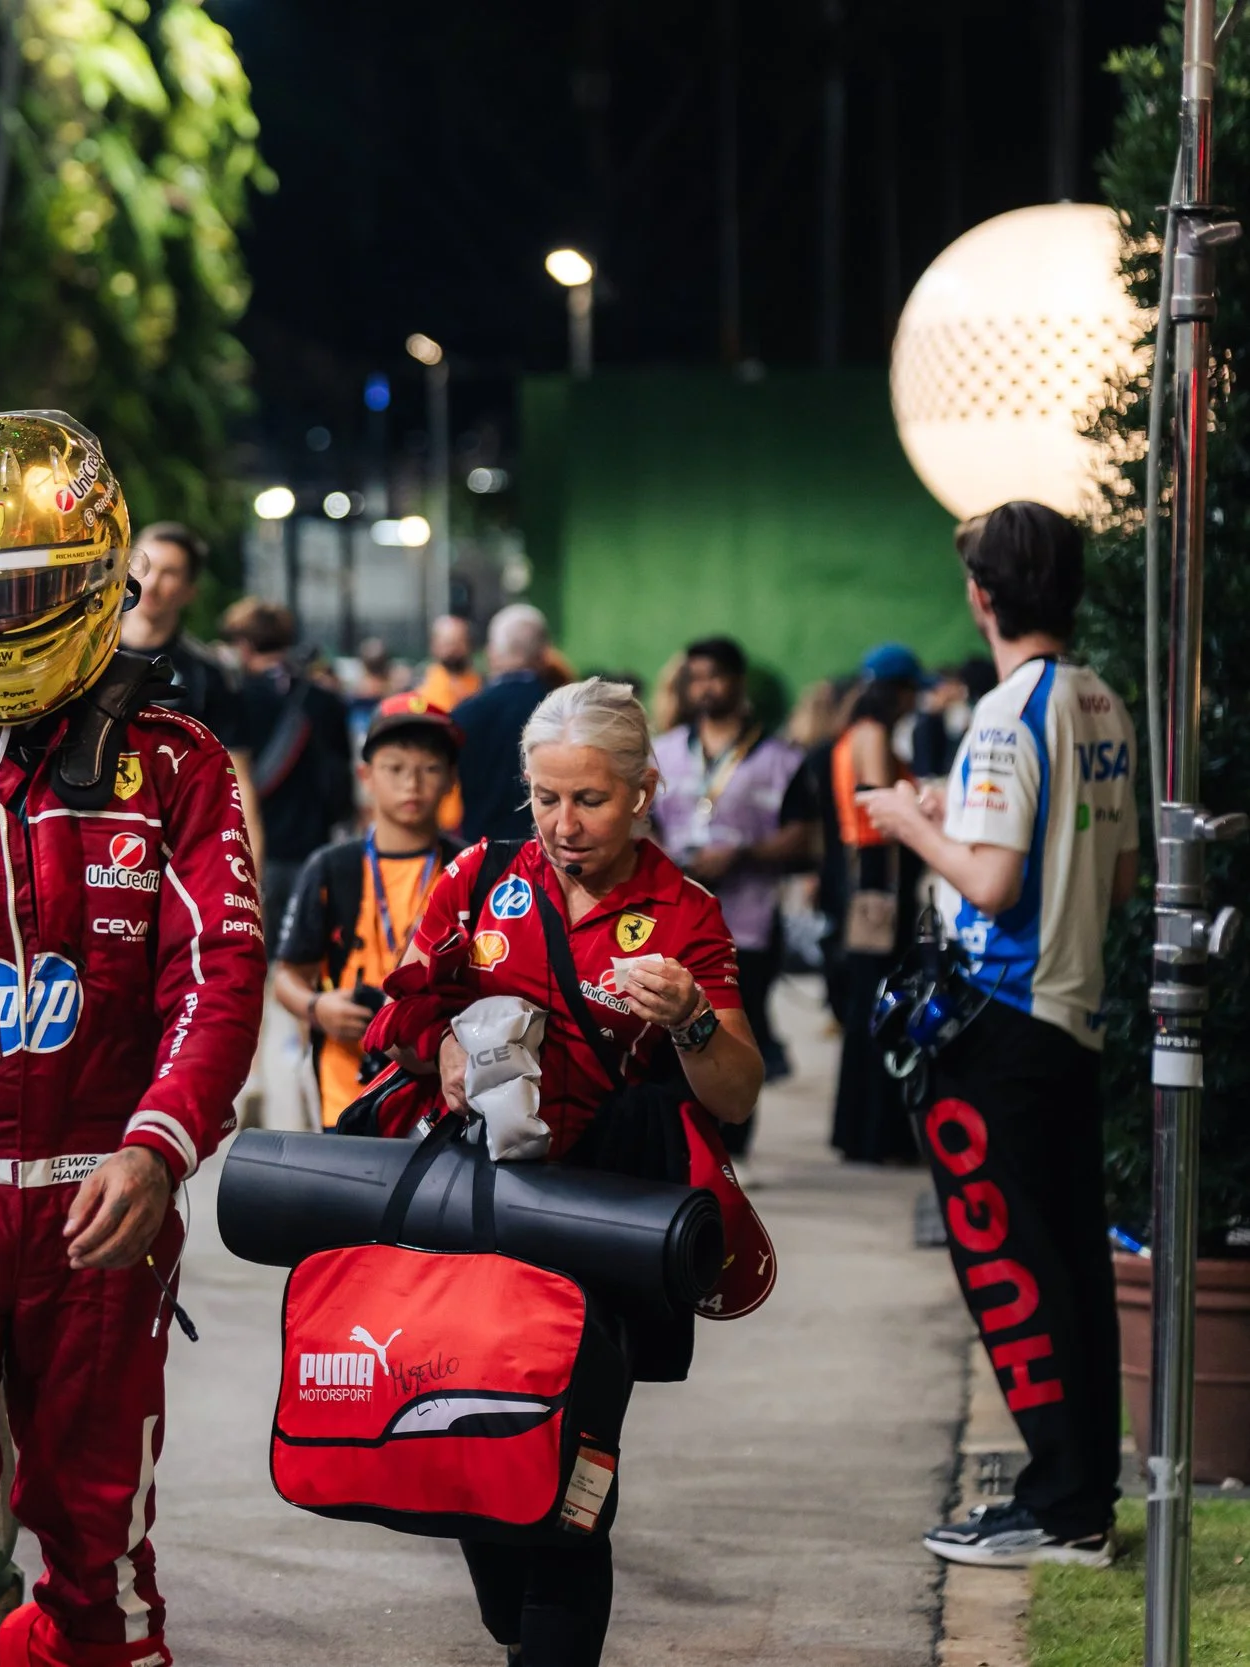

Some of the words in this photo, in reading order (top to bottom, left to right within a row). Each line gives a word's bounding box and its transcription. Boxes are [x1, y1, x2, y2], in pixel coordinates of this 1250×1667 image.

[88, 866, 160, 892] UniCredit
[470, 1045, 511, 1070] ICE
[51, 1156, 98, 1170] LEWIS
[924, 1097, 1065, 1413] HUGO
[299, 1353, 375, 1387] PUMA
[299, 1388, 373, 1403] MOTORSPORT
